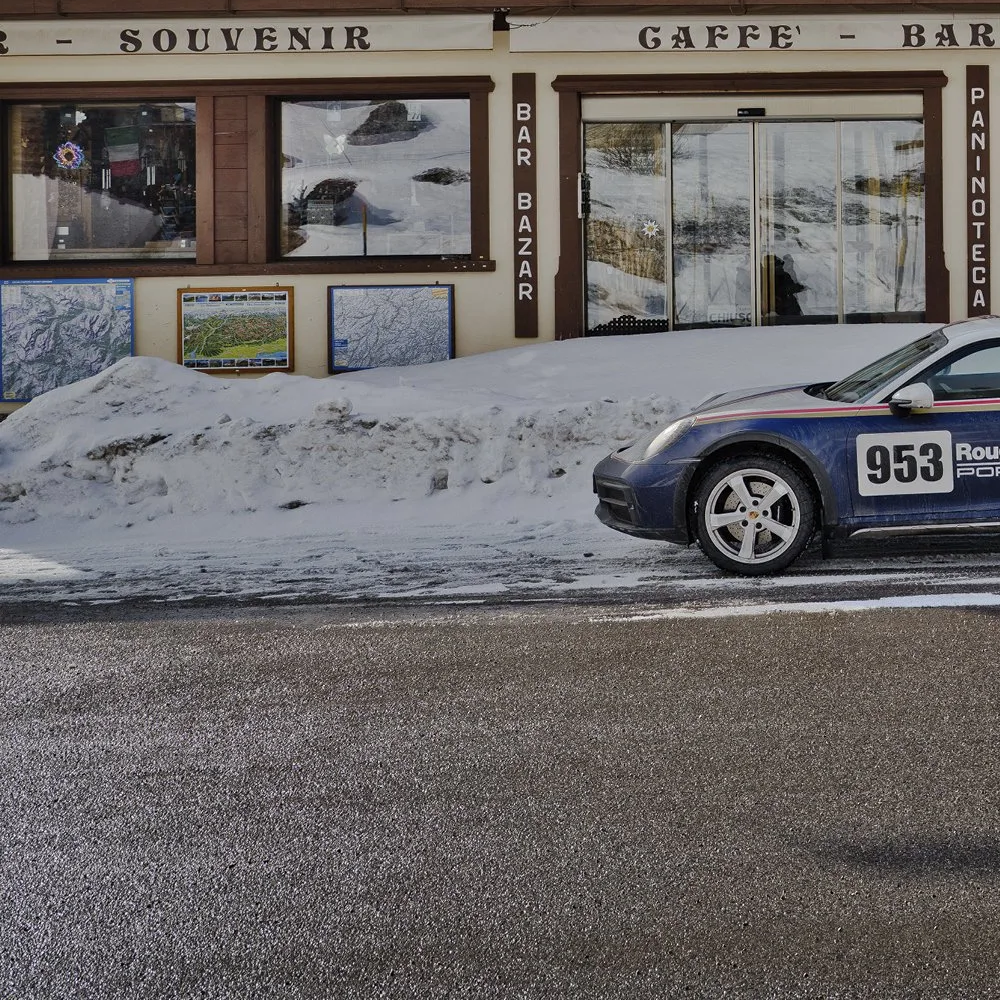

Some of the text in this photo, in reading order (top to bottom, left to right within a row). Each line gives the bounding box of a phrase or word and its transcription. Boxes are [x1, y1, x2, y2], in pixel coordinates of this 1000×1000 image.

[119, 25, 371, 53] SOUVENIR
[901, 23, 996, 48] BAR
[516, 102, 533, 301] BAR BAZAR
[970, 87, 986, 308] PANINOTECA
[866, 442, 944, 485] 953
